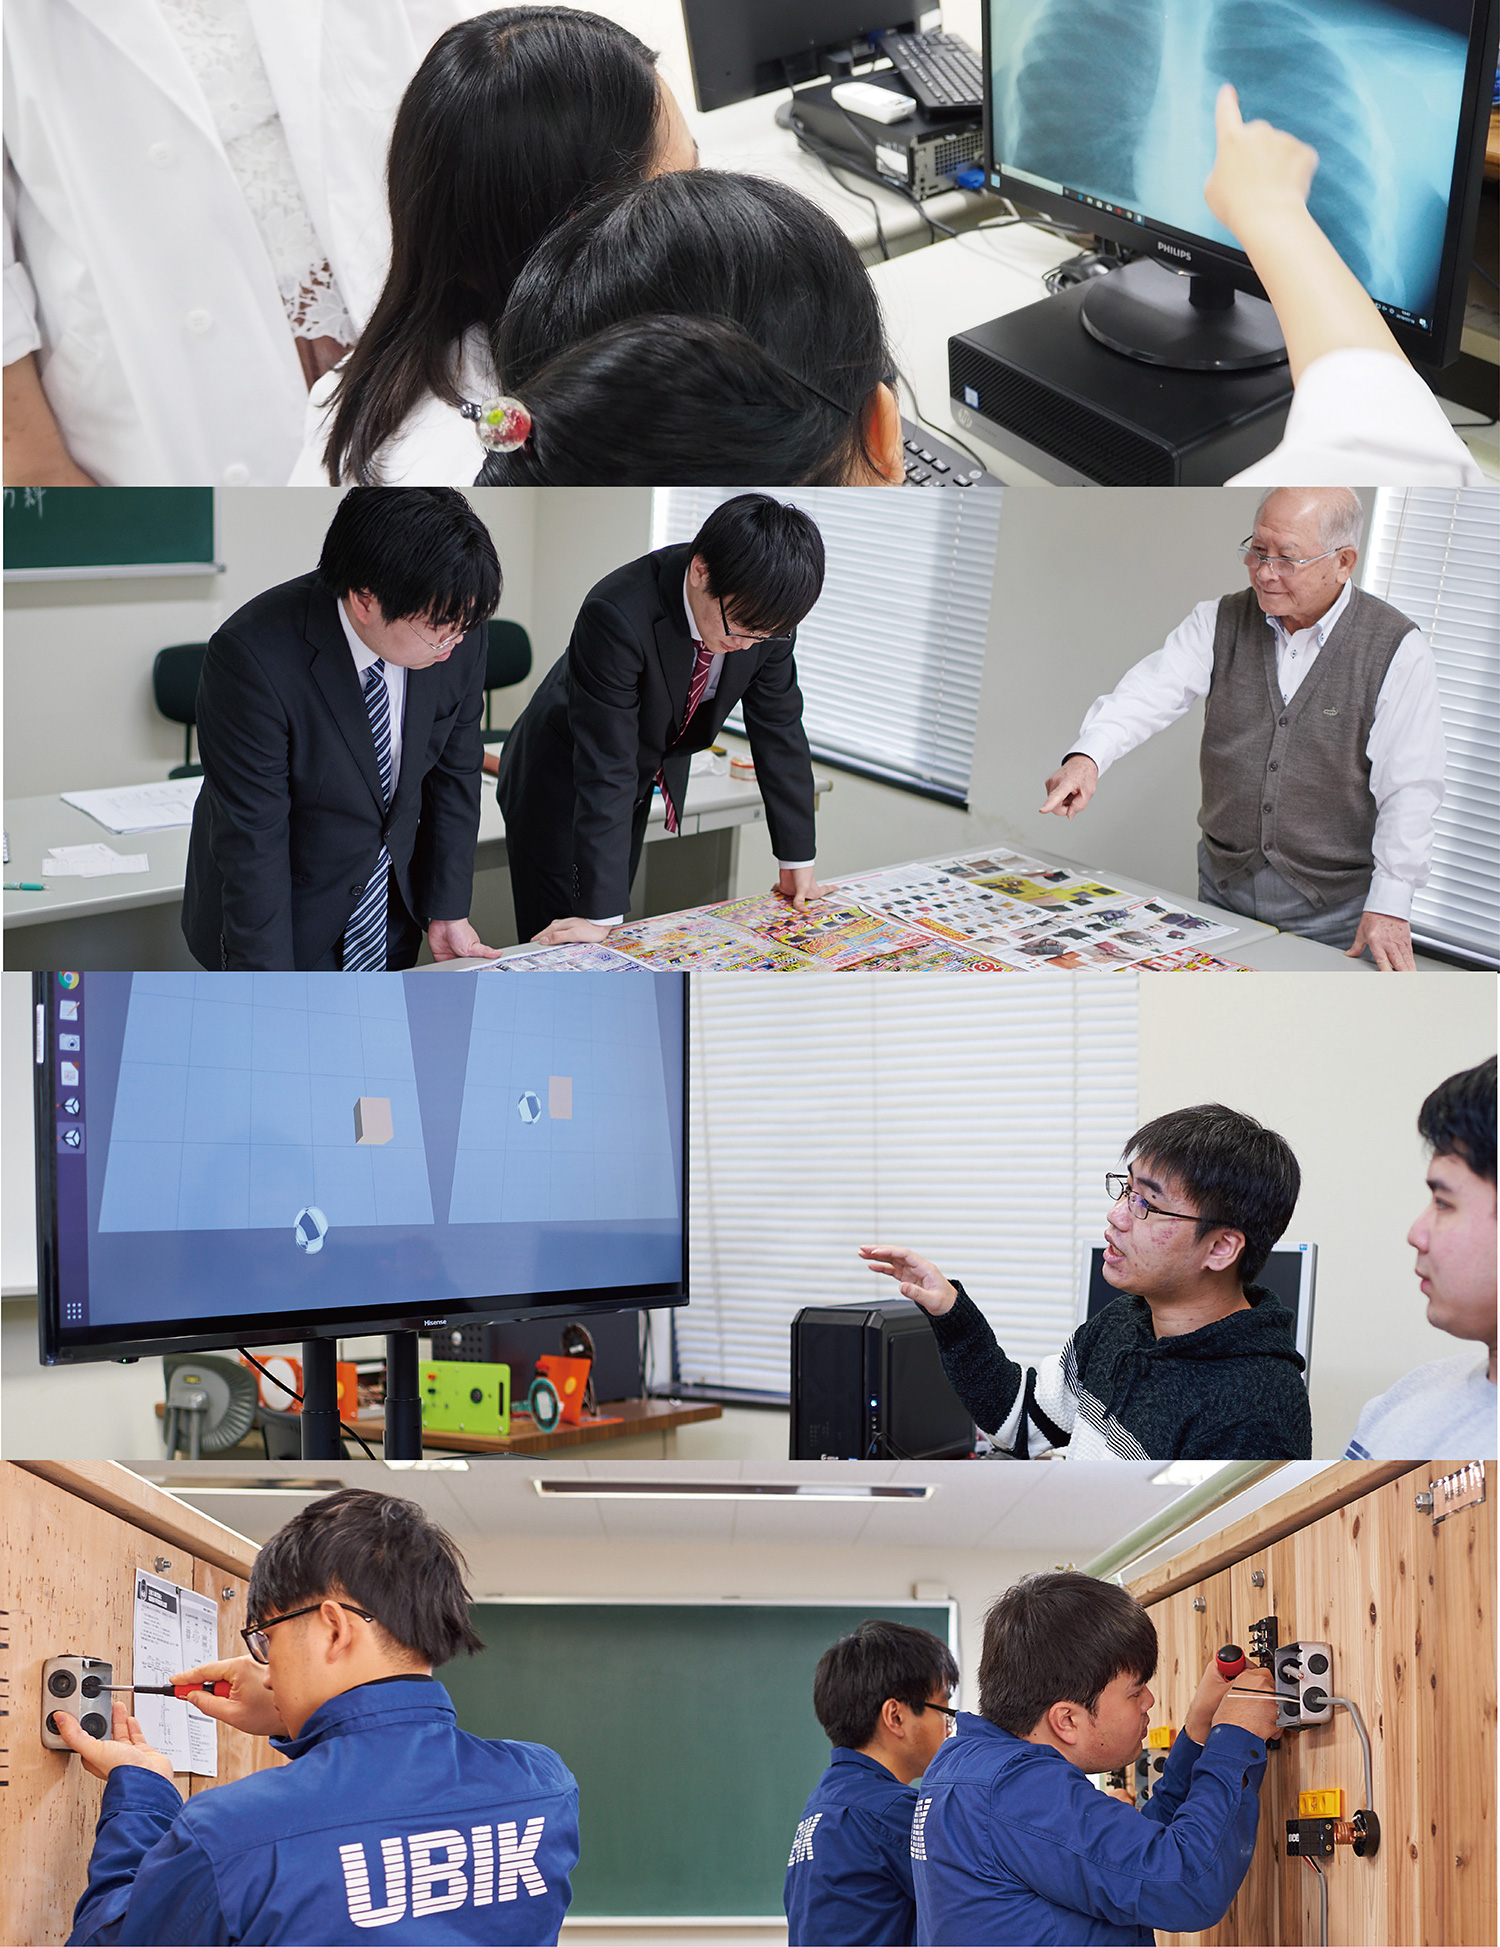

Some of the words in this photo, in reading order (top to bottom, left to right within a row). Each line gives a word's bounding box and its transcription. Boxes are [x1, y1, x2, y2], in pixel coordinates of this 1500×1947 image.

[1157, 241, 1192, 262] PHILIPS
[423, 1319, 447, 1327] Hisense
[338, 1816, 548, 1928] UBIK
